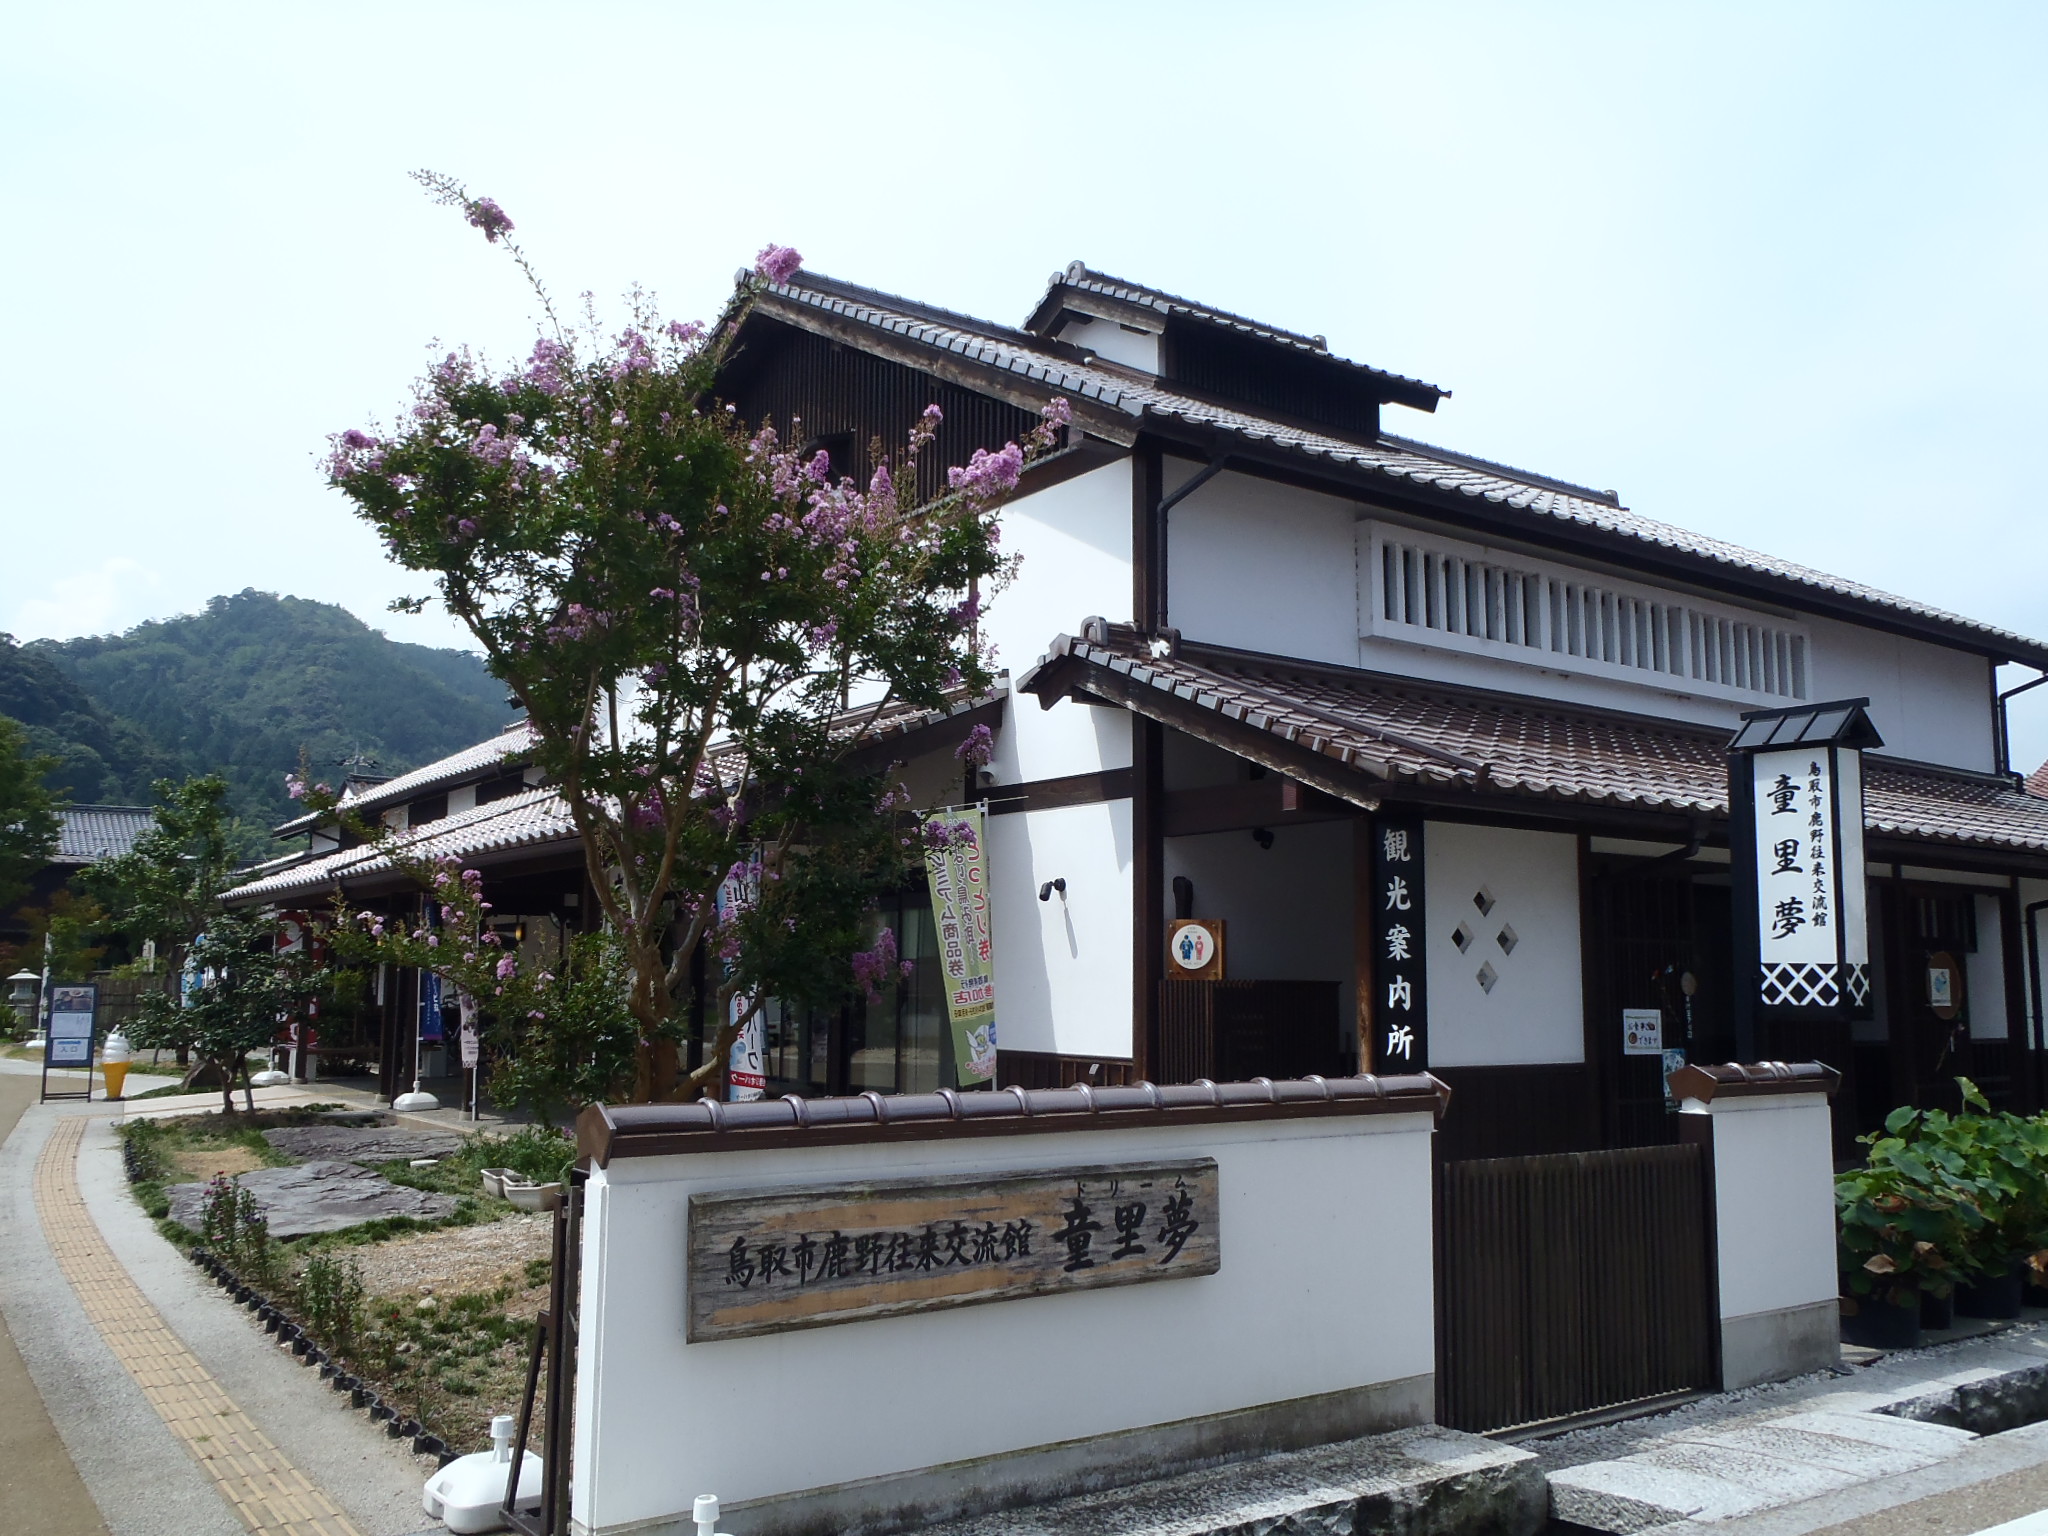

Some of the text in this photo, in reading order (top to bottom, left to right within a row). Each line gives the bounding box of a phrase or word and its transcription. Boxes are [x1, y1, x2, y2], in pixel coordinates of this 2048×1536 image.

[1766, 774, 1806, 940] 童里夢
[1807, 761, 1828, 928] 鳥取市鹿野往来交流館
[1383, 828, 1414, 1060] 観光案内所
[725, 1189, 1199, 1288] 鳥取市鹿野往来交流館 童里夢
